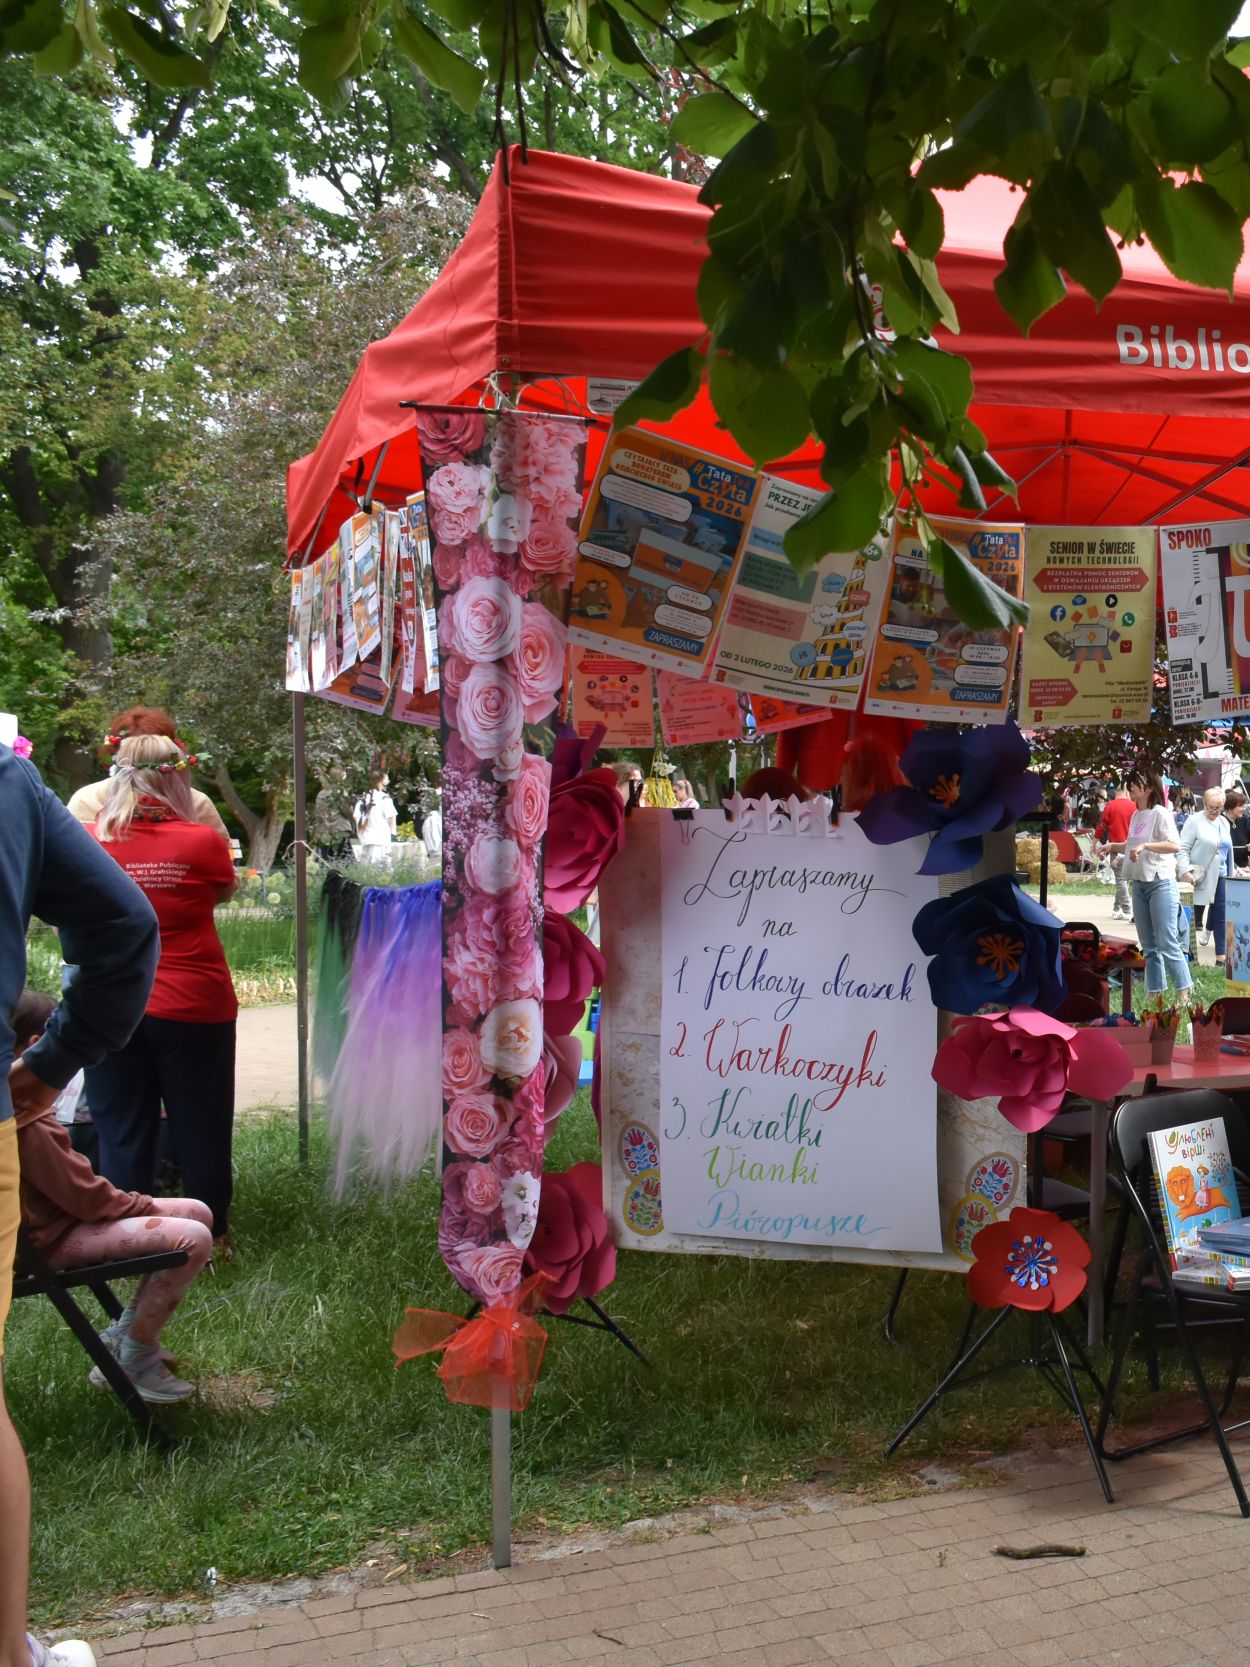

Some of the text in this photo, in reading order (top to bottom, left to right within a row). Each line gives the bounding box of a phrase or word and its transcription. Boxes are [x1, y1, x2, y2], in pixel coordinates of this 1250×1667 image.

[707, 496, 743, 518] 2026
[768, 491, 801, 510] PRZEZ
[1049, 539, 1136, 554] SENIOR W ŚWIECIE
[1167, 527, 1212, 551] SPOKO
[987, 561, 1016, 573] 2026
[1046, 555, 1139, 565] NOWYCH TECHNOLOGII
[649, 630, 700, 653] ZAPRASZAMY
[720, 650, 733, 659] OD
[740, 656, 772, 669] LUTEGO
[773, 664, 795, 674] 2026
[954, 689, 999, 702] ZAPRASZAMY
[684, 826, 907, 926] Zapraszamy
[762, 916, 798, 937] na
[704, 944, 810, 1021] Folkowy
[822, 952, 915, 1002] obrazek
[704, 1017, 888, 1111] Warkoczyki
[700, 1086, 824, 1148] Kwiatki
[704, 1145, 819, 1189] Wianki
[697, 1190, 891, 1239] Pióropusze
